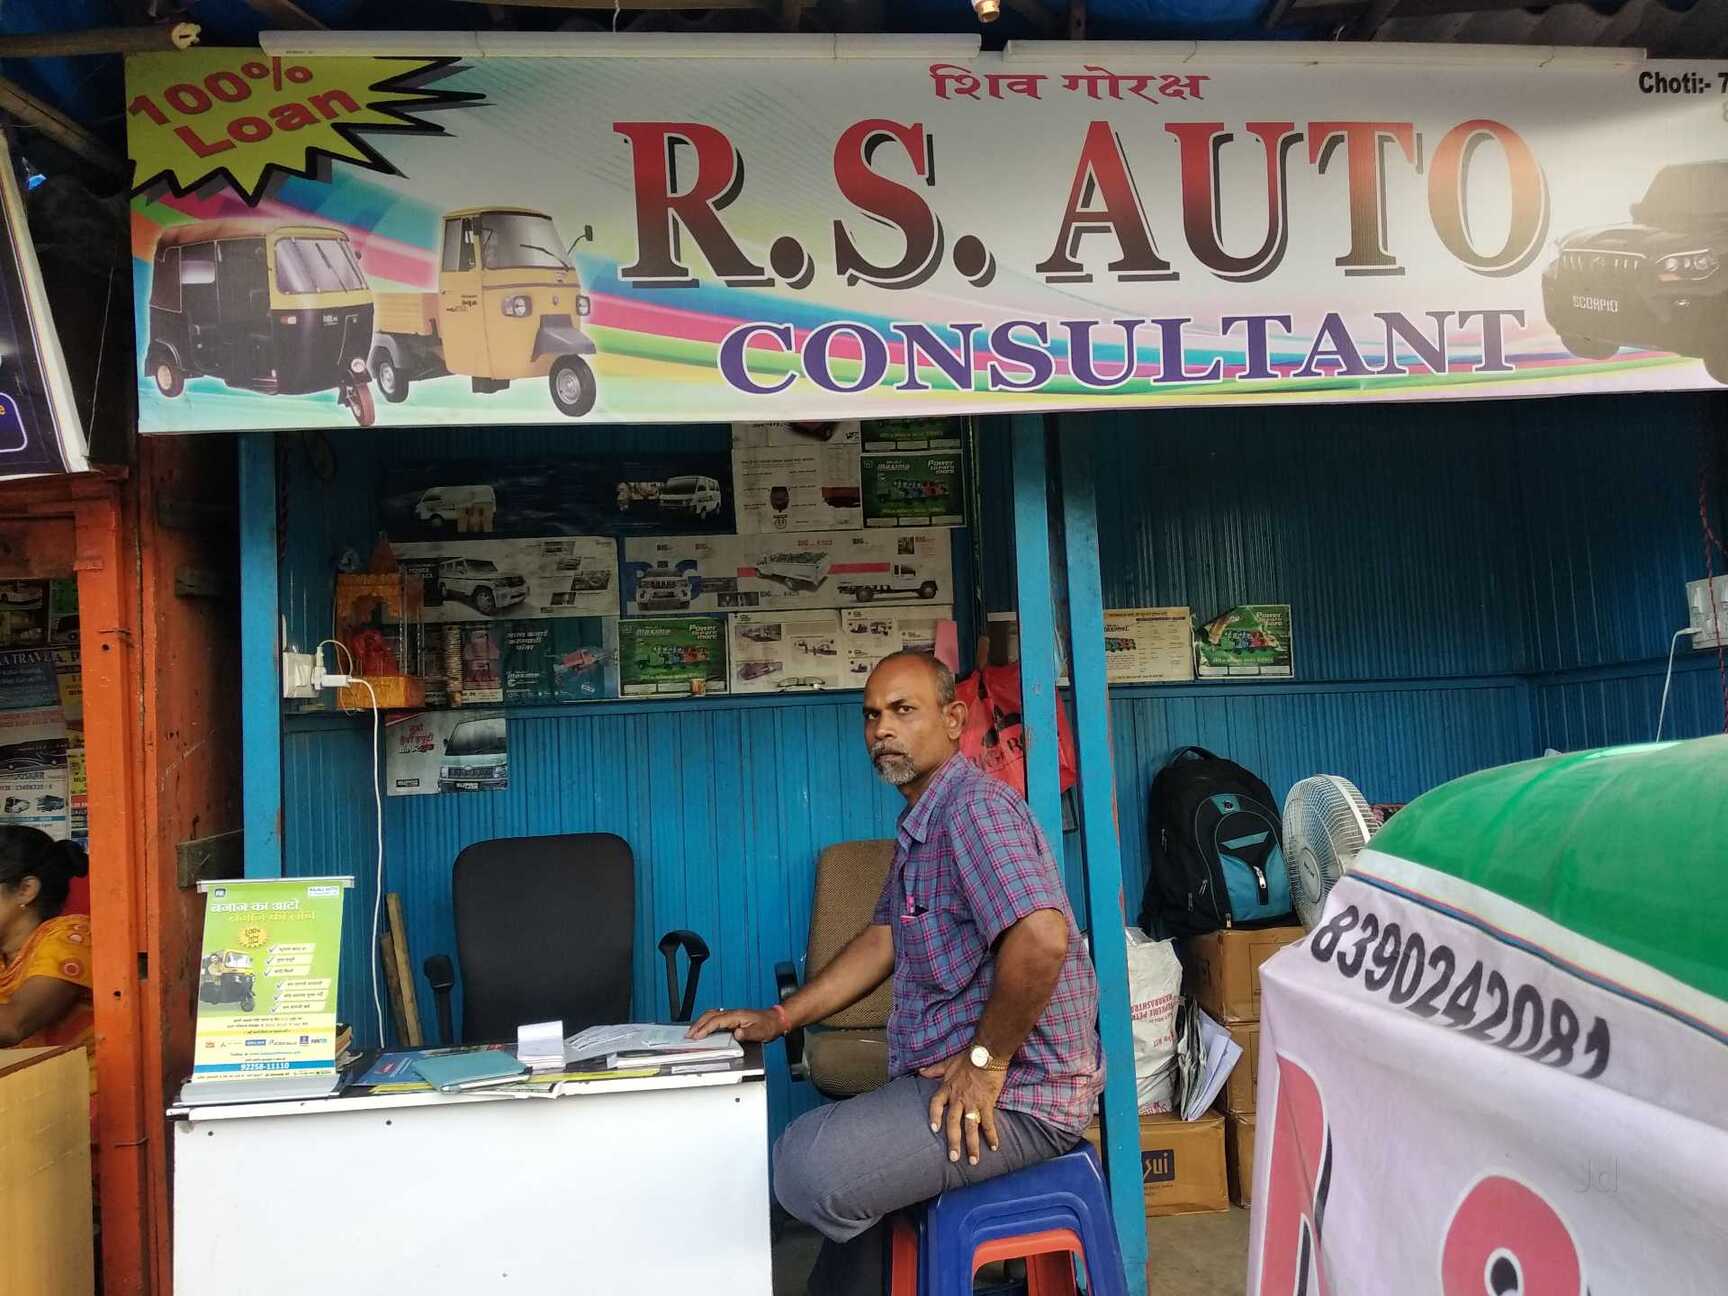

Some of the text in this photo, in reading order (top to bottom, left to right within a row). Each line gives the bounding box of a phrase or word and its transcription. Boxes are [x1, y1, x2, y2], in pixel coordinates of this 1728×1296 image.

[128, 56, 313, 126] 100%
[929, 63, 1211, 105] शिव गोरक्ष
[1639, 72, 1712, 95] Choti:-
[173, 90, 361, 158] Loan
[1035, 117, 1552, 284] AUTO
[1572, 295, 1619, 313] SCORPIO
[718, 309, 1529, 395] CONSULTANT
[1310, 905, 1611, 1080] 8390242081
